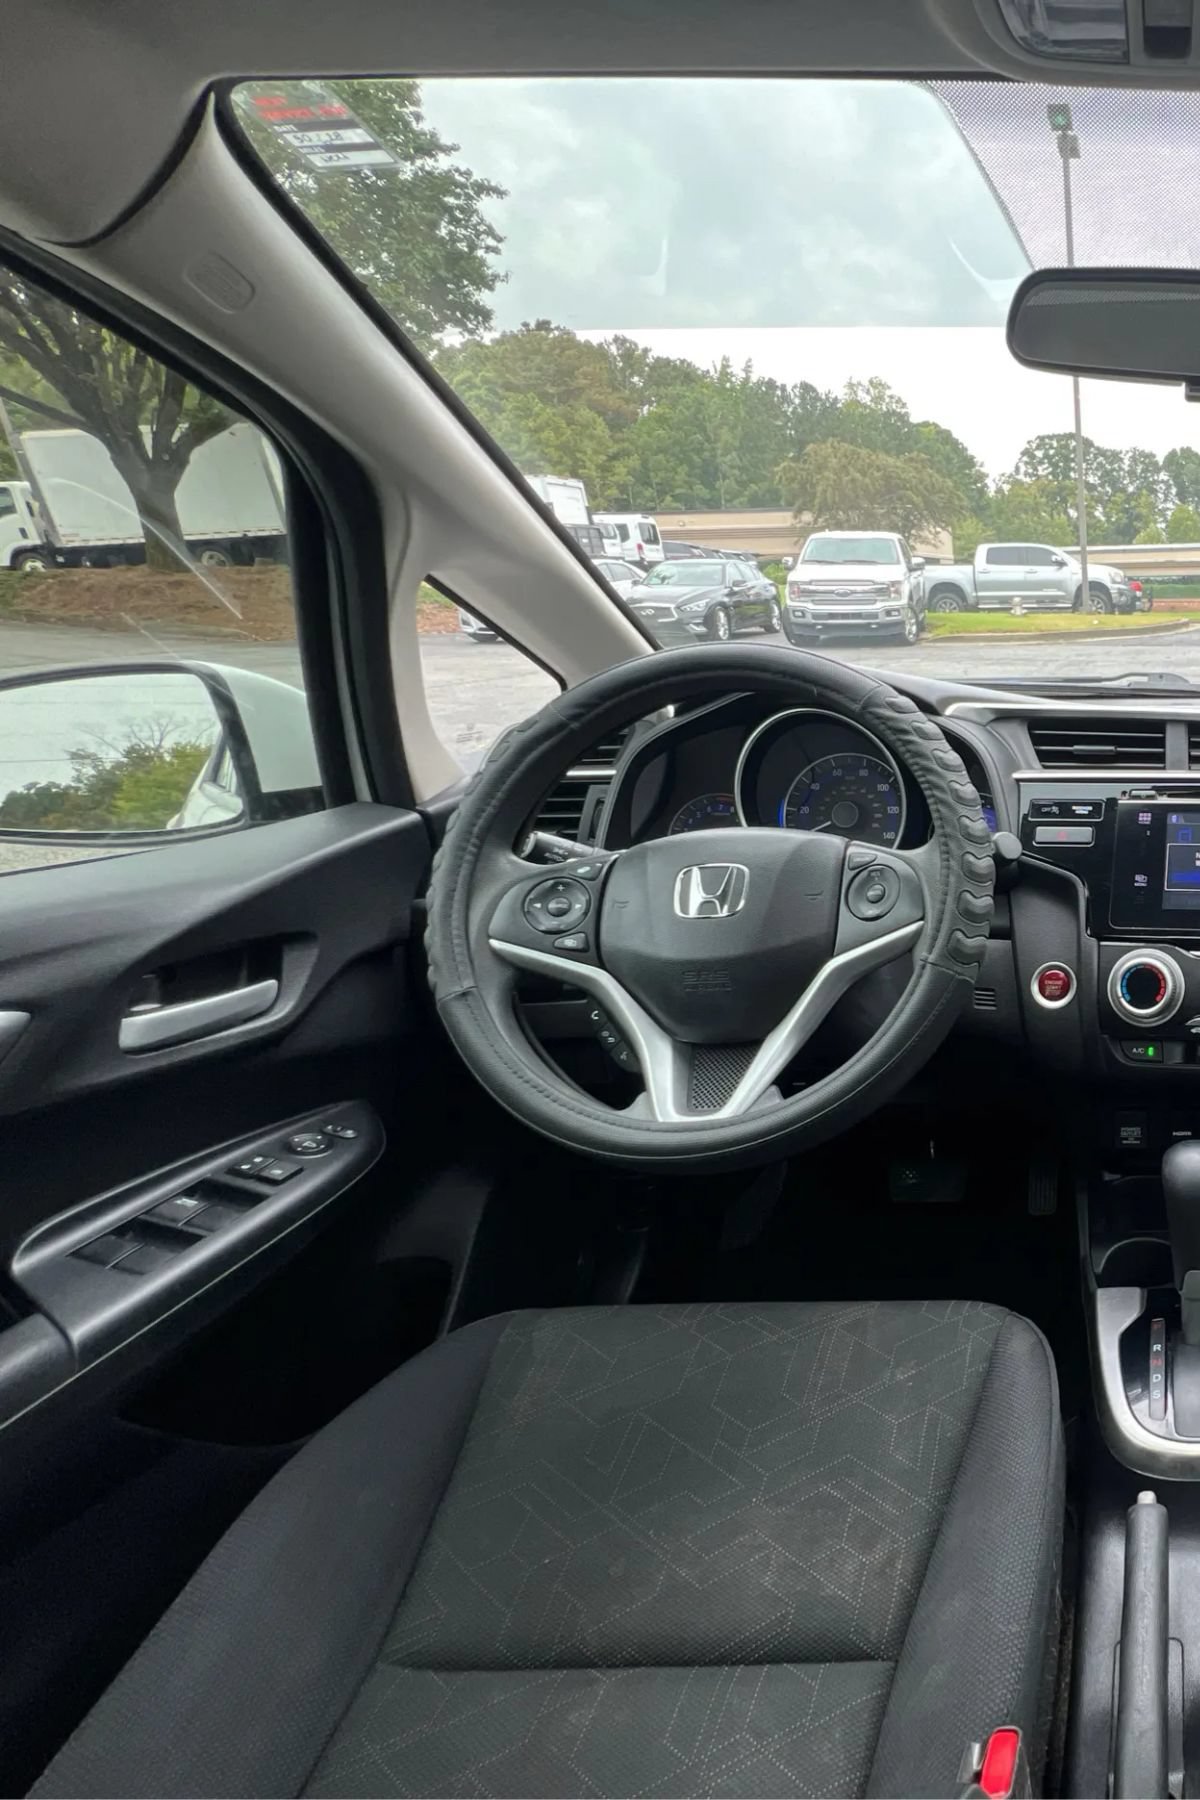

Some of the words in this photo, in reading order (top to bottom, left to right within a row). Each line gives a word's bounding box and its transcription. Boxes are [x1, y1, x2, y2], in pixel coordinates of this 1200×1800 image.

[877, 783, 889, 792] 100
[800, 806, 809, 814] 20
[887, 806, 899, 814] 120
[1152, 1374, 1161, 1382] D
[1152, 1390, 1161, 1399] S
